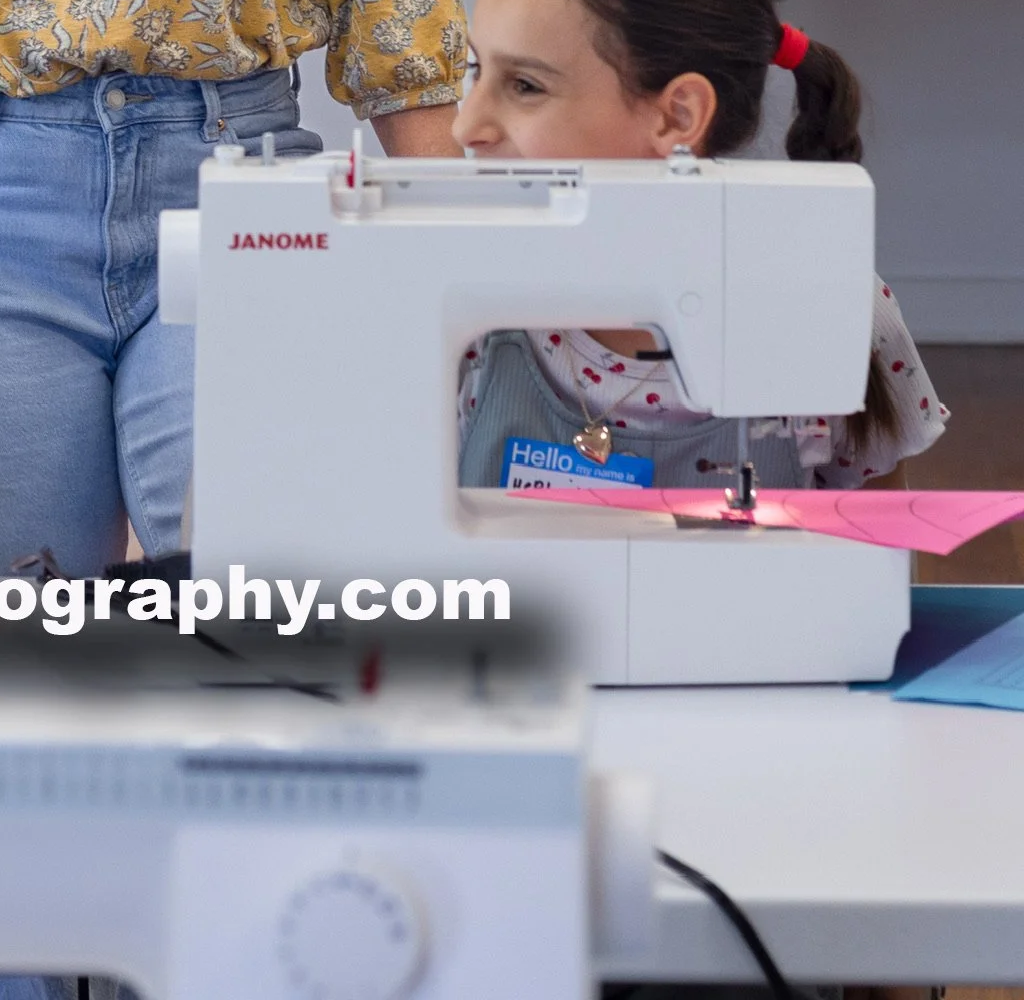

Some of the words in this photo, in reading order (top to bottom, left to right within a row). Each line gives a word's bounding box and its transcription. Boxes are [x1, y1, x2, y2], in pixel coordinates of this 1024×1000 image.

[228, 232, 329, 250] JANOME
[511, 442, 573, 472] Hello
[576, 465, 591, 477] my
[593, 467, 624, 480] name
[624, 472, 635, 482] is
